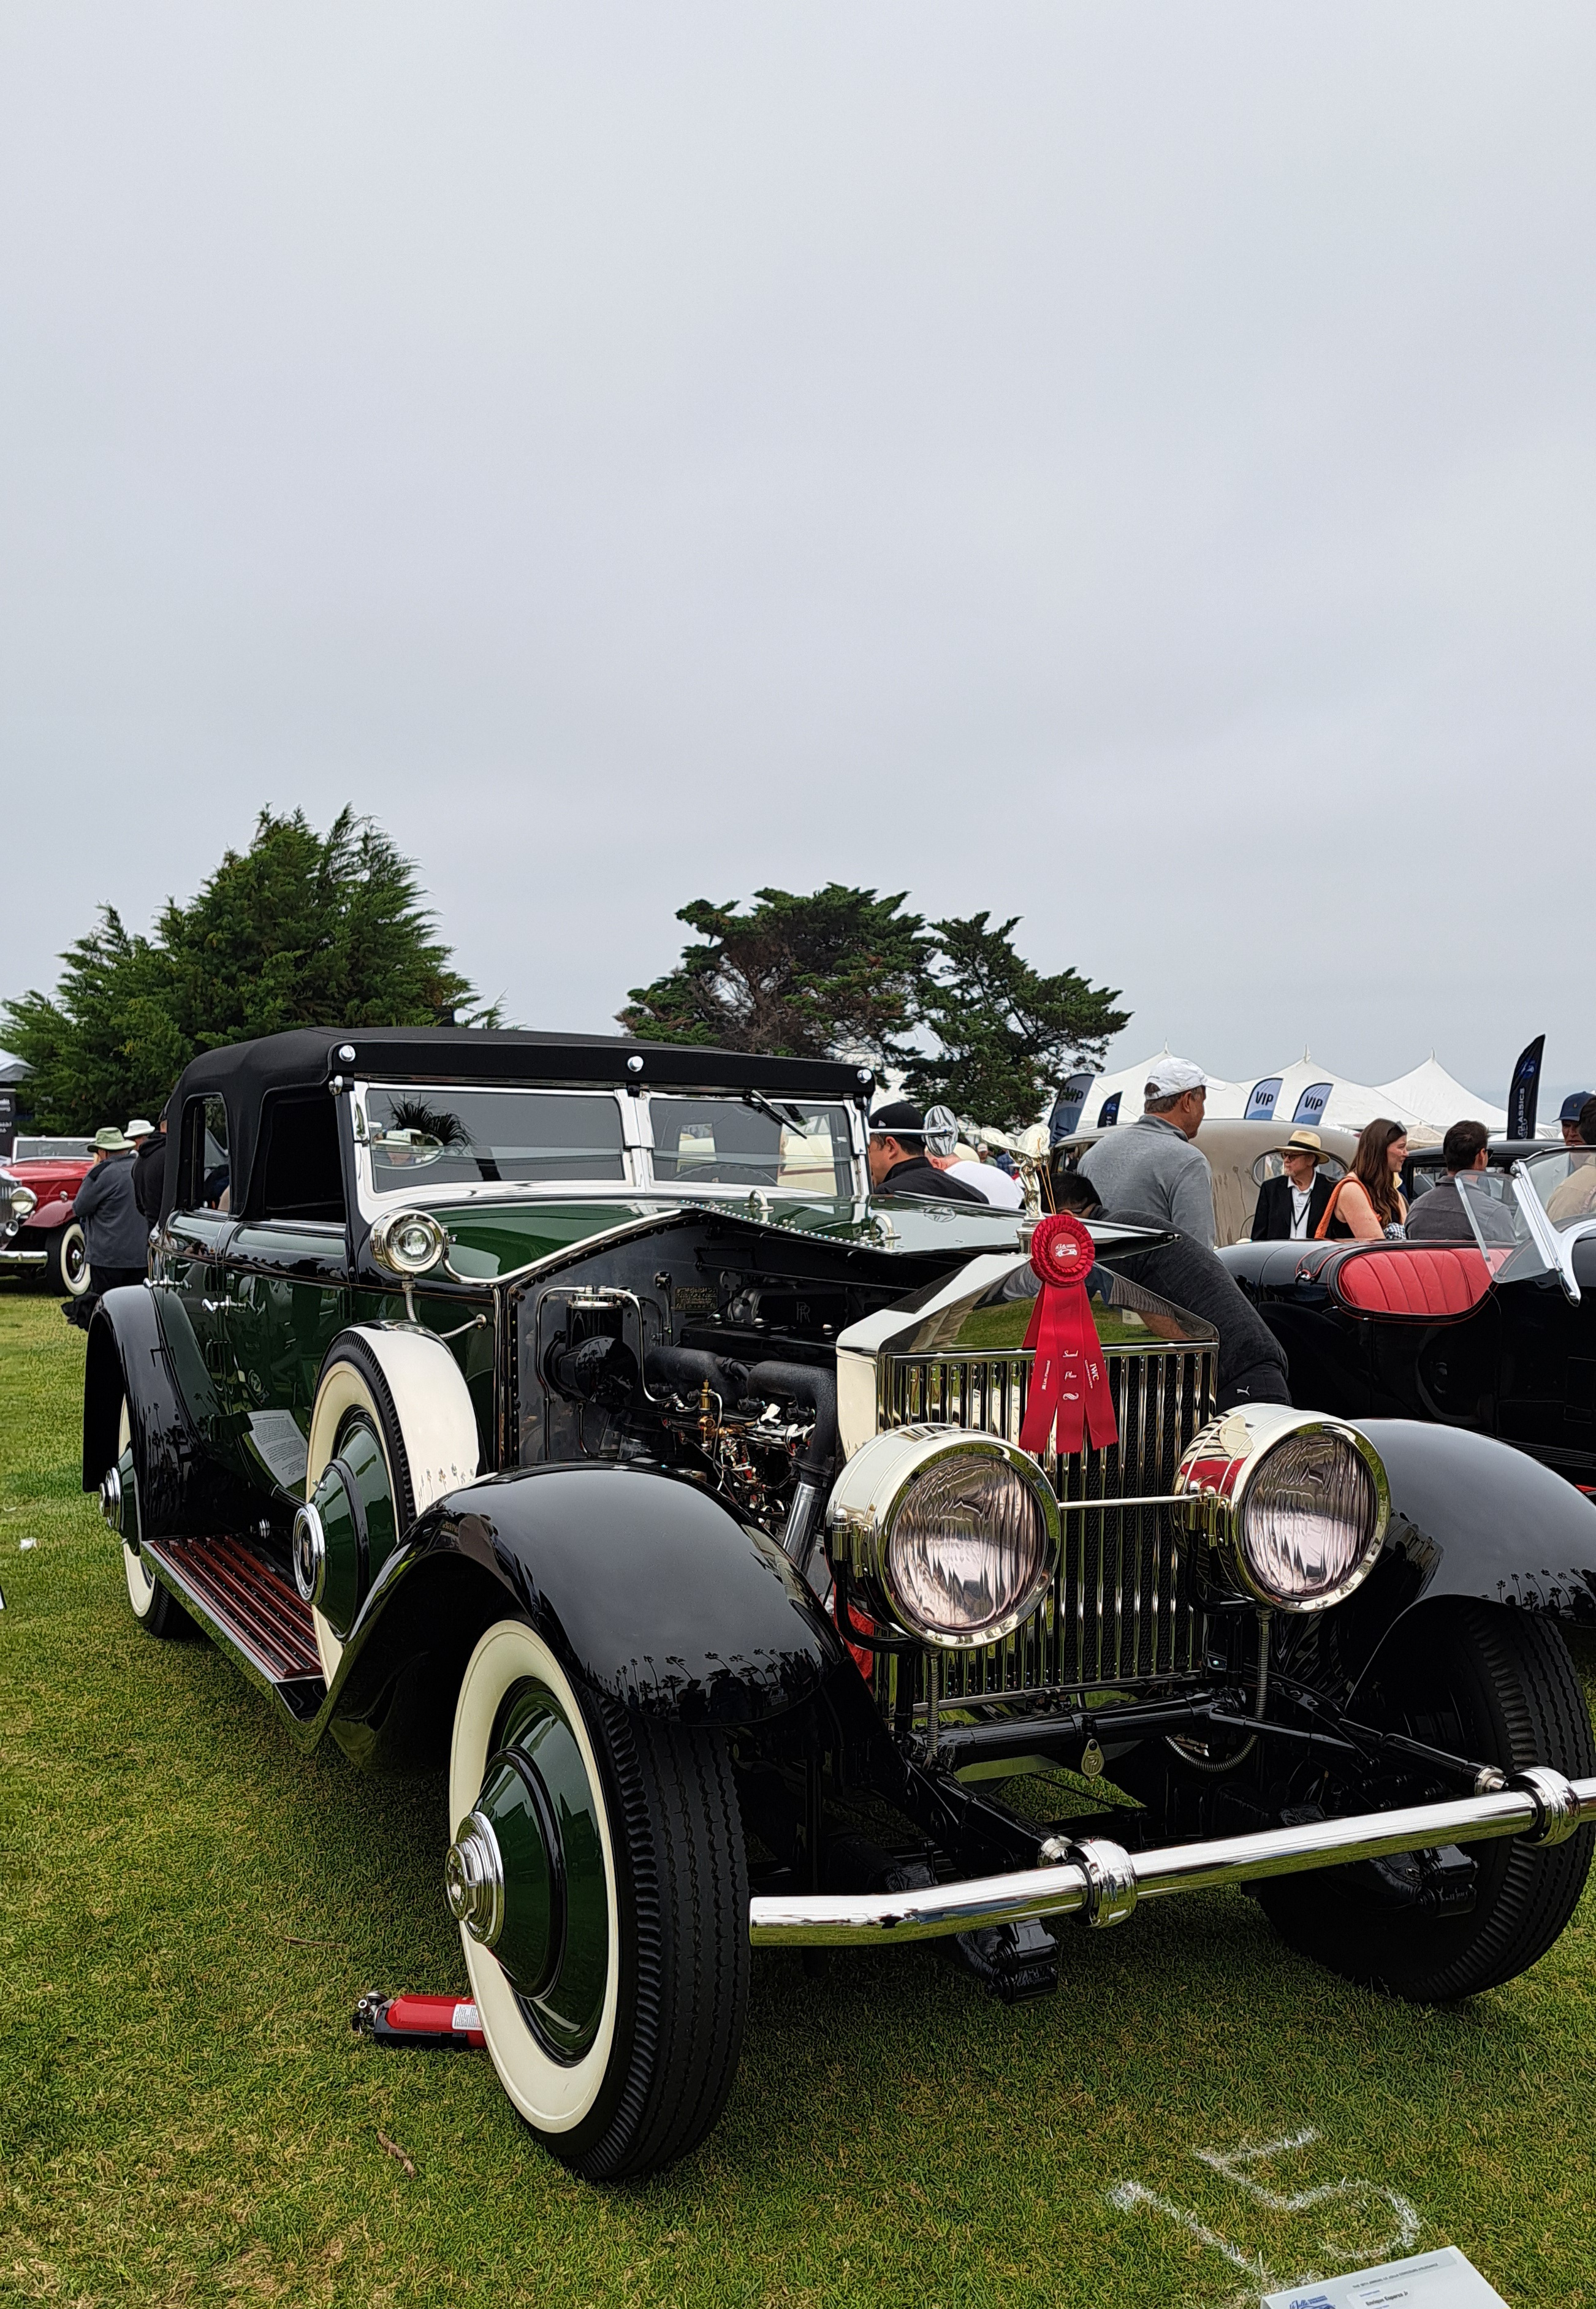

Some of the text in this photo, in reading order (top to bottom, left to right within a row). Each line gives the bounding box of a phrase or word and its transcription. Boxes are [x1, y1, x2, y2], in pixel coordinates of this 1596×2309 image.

[1256, 1091, 1274, 1106] VIP
[1304, 1095, 1323, 1111] VIP
[1090, 1363, 1099, 1382] IWC
